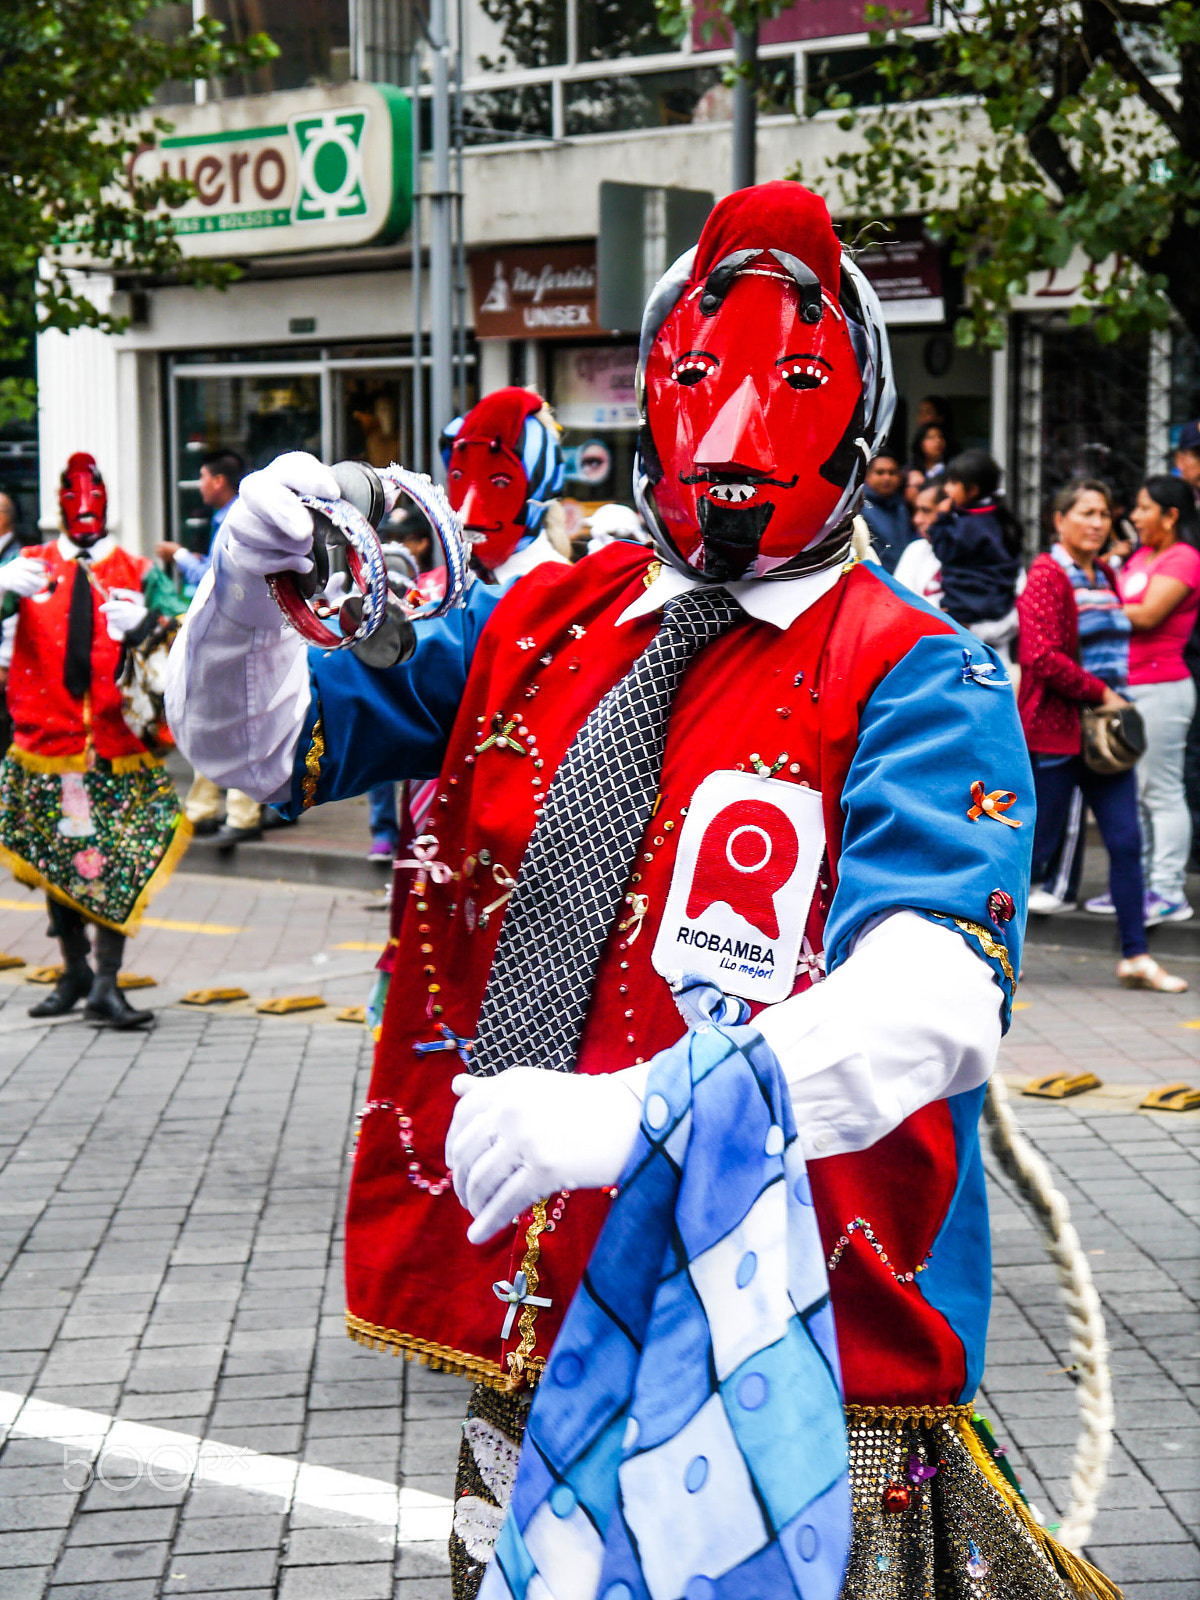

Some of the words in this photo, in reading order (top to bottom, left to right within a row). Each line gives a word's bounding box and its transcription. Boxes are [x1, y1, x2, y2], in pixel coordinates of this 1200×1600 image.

[219, 211, 274, 230] BOLSOS
[523, 304, 591, 328] UNISEX
[676, 926, 775, 966] RIOBAMBA
[738, 963, 775, 979] mejor!
